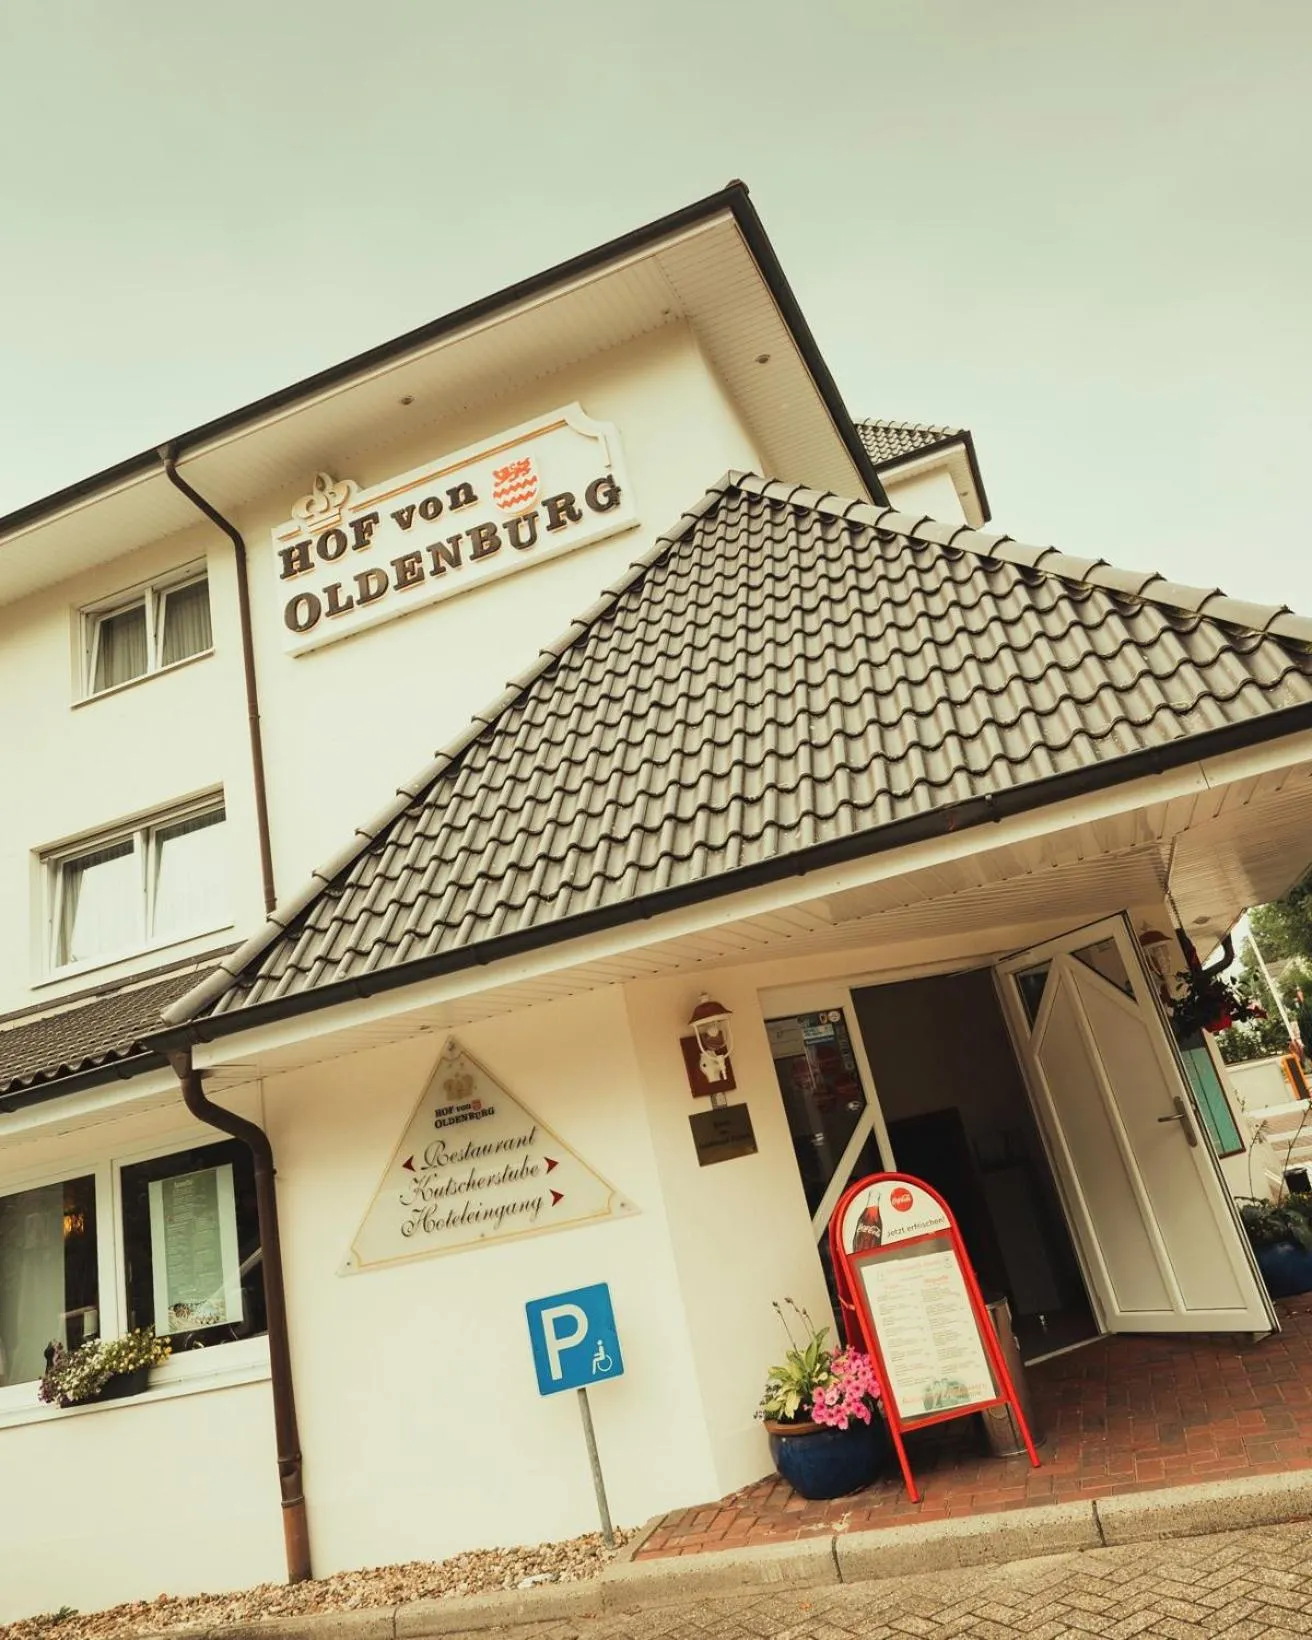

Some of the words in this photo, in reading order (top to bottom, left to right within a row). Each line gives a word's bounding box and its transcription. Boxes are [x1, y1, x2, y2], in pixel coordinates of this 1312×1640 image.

[279, 511, 381, 580] HOF
[390, 481, 479, 531] von
[284, 474, 621, 633] OLDENBURG
[434, 1105, 454, 1118] HOF
[434, 1106, 495, 1129] OLDENBURG
[420, 1125, 537, 1171] Restaurant
[400, 1153, 541, 1206] Kutscherstube
[400, 1196, 544, 1238] Hoteleingang
[541, 1303, 589, 1381] P
